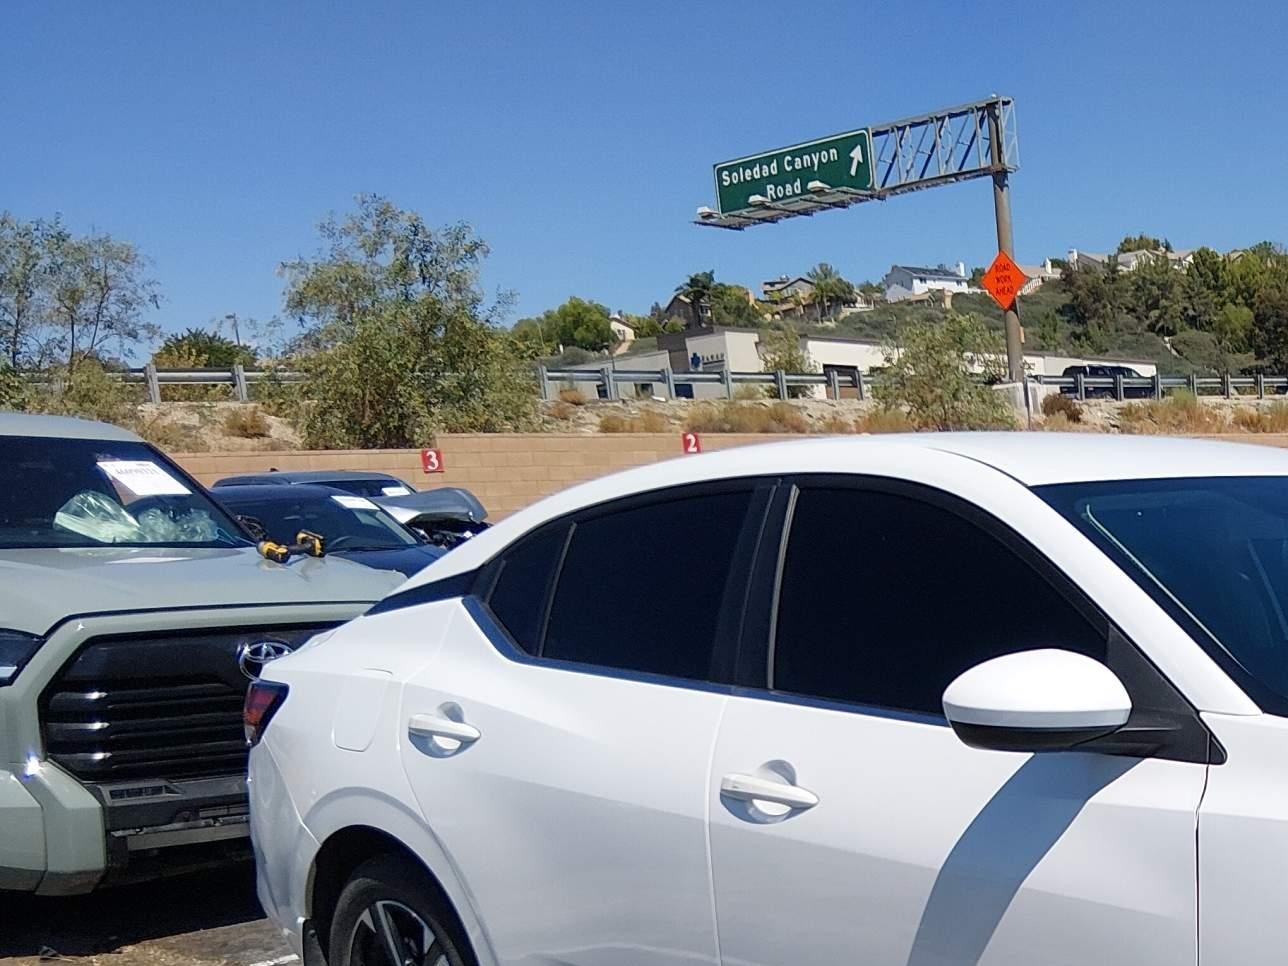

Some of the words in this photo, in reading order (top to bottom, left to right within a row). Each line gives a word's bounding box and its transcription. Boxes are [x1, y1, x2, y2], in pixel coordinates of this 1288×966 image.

[722, 159, 778, 187] Soledad
[784, 147, 838, 171] Canyon
[767, 178, 802, 200] Road
[686, 433, 698, 452] 2
[426, 451, 439, 470] 3
